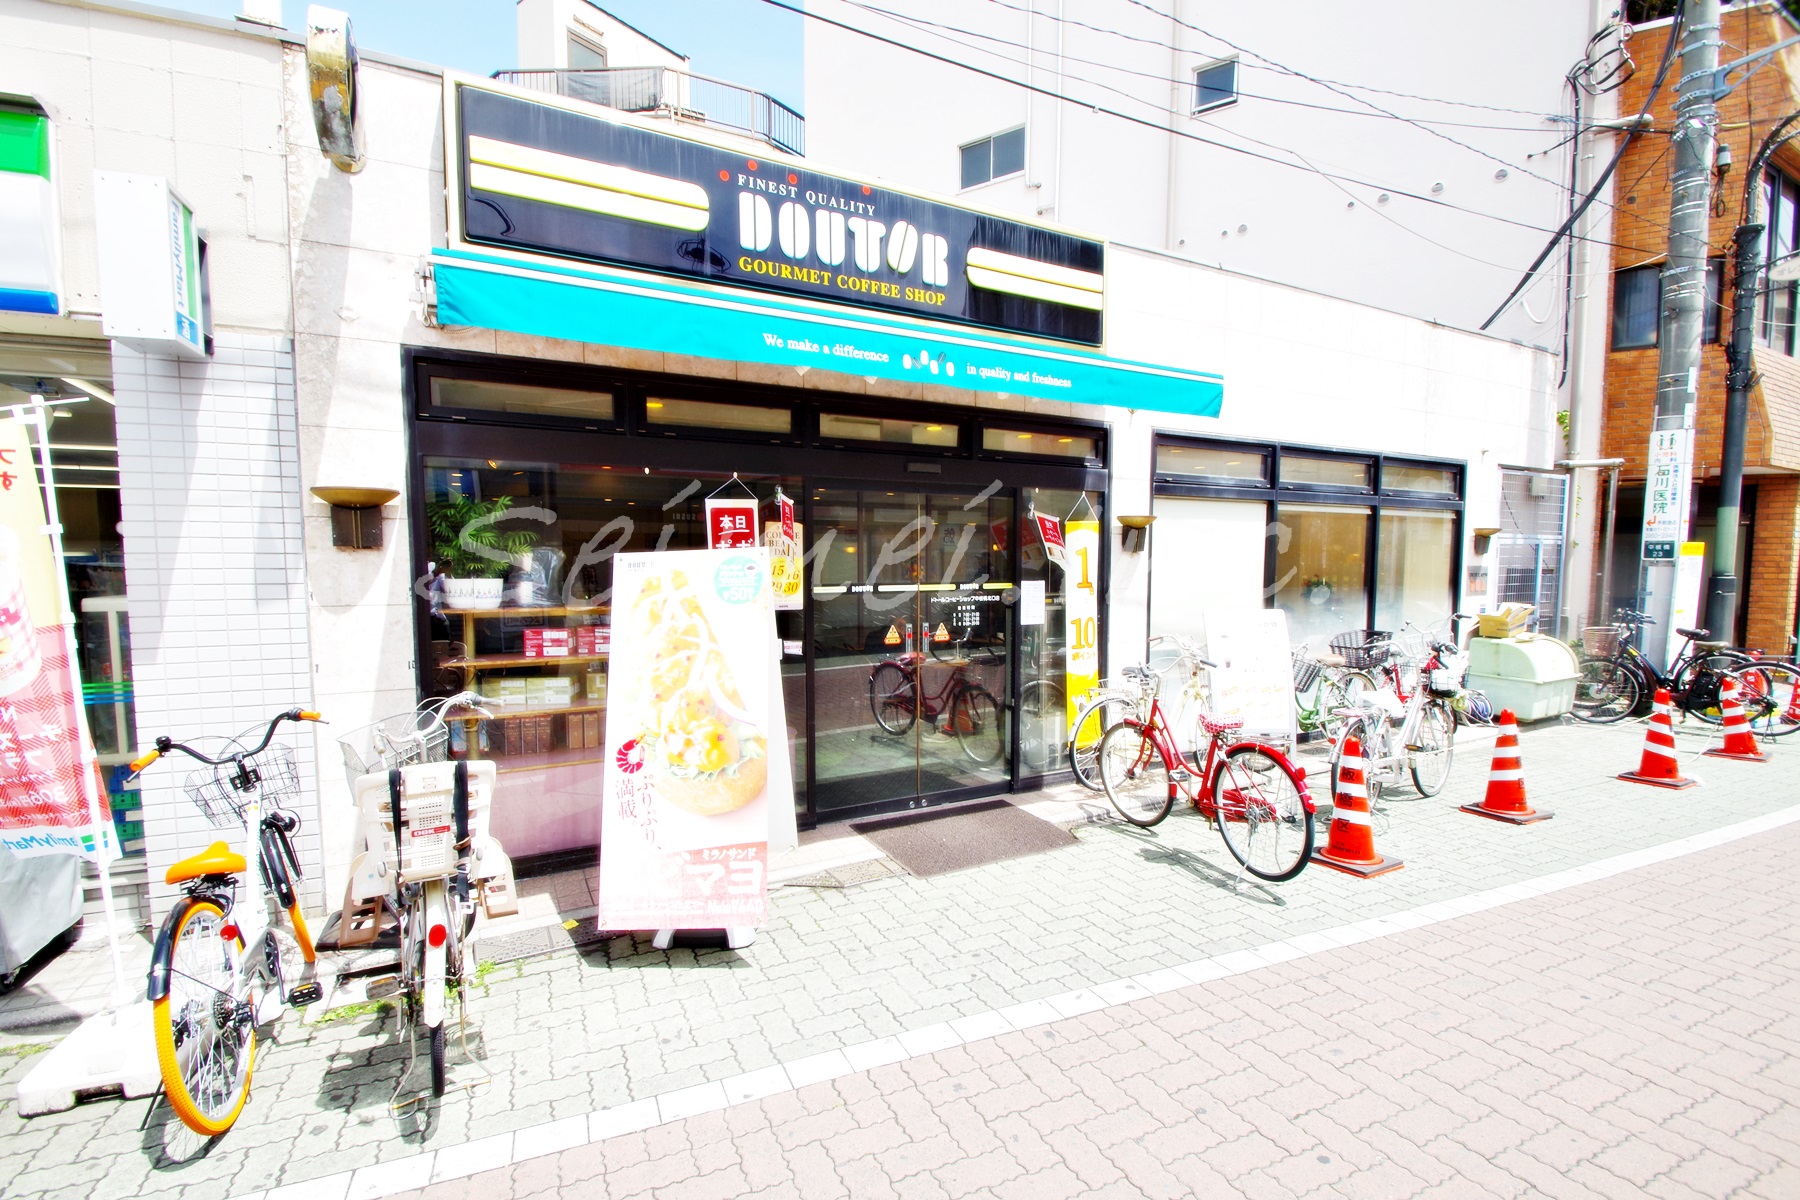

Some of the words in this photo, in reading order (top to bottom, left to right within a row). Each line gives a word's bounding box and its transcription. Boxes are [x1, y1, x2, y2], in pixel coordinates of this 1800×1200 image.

[738, 174, 798, 199] FINEST
[805, 190, 876, 216] QUALITY
[172, 201, 185, 310] FamilyMart
[738, 191, 949, 287] DOUTOR
[738, 256, 832, 286] GOURMET
[836, 273, 901, 298] COFFEE
[905, 287, 946, 306] SHOP
[762, 333, 785, 348] We
[787, 340, 819, 352] make
[823, 345, 831, 354] a
[832, 343, 890, 363] difference
[966, 362, 977, 374] in
[978, 365, 1011, 381] quality
[1013, 370, 1030, 381] and
[1031, 371, 1072, 388] freshness
[1652, 464, 1671, 514] 石川医院
[719, 515, 747, 529] 本日
[772, 565, 785, 576] 15
[783, 581, 799, 593] 30
[1071, 617, 1096, 649] 10
[615, 778, 638, 827] 満載。
[701, 847, 757, 861] ミラノサンド
